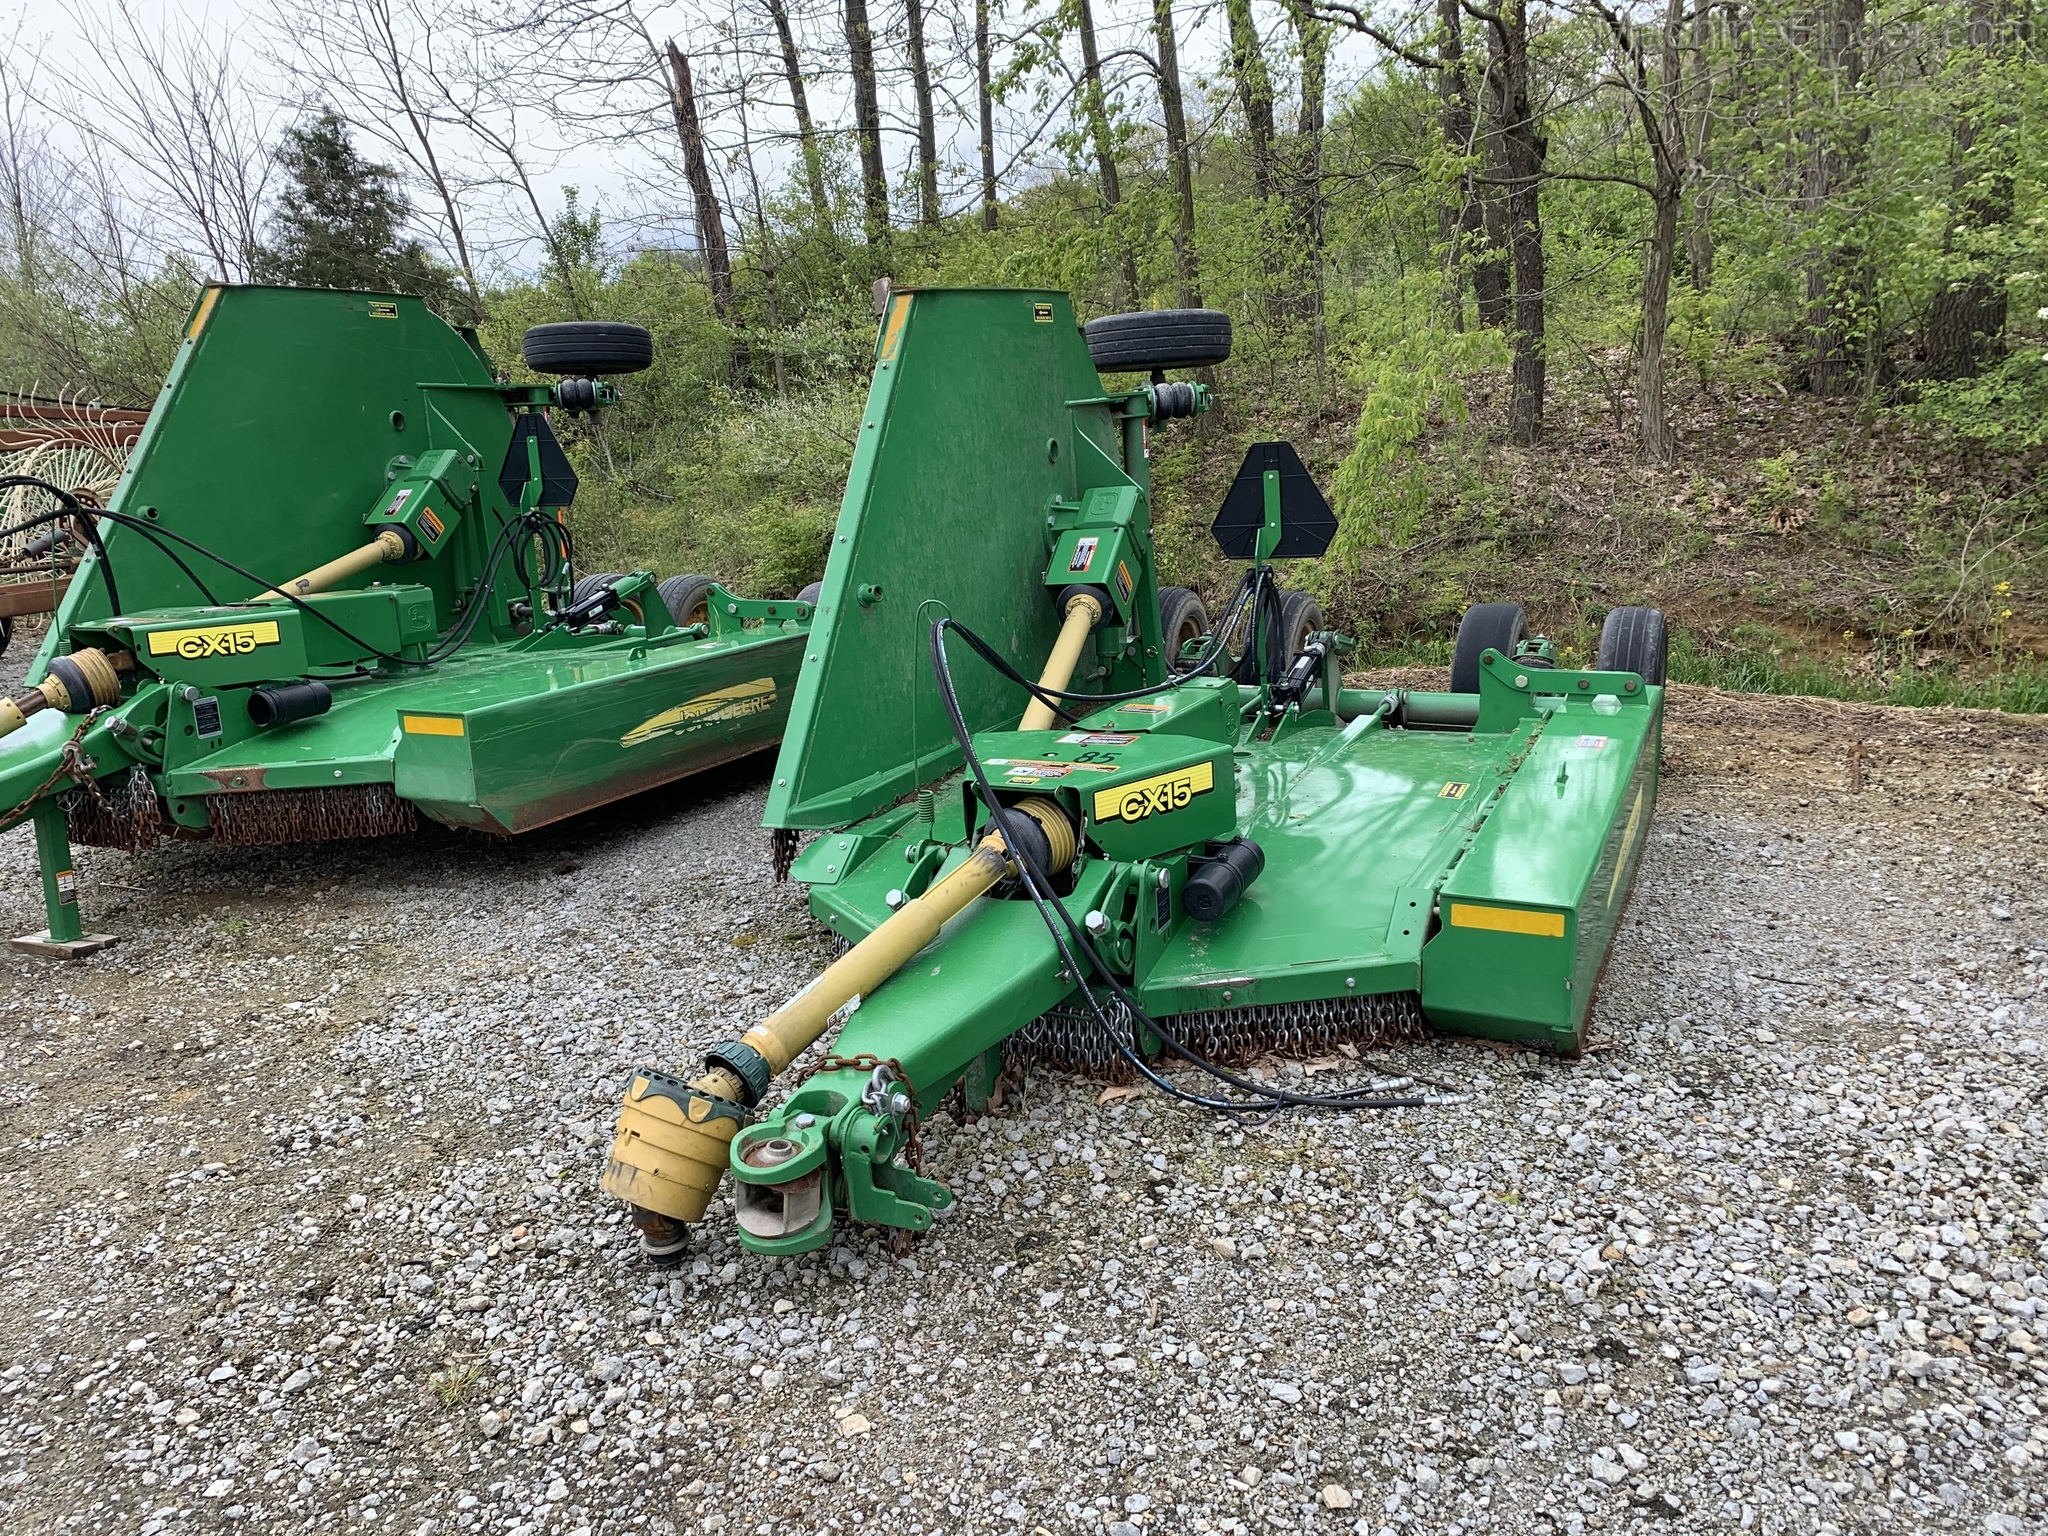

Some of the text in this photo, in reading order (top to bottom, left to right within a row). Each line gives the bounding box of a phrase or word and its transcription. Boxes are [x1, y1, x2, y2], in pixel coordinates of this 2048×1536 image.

[176, 630, 257, 660] CX15
[720, 694, 771, 720] DEERE
[1073, 751, 1123, 764] 85
[1120, 776, 1192, 825] CX15
